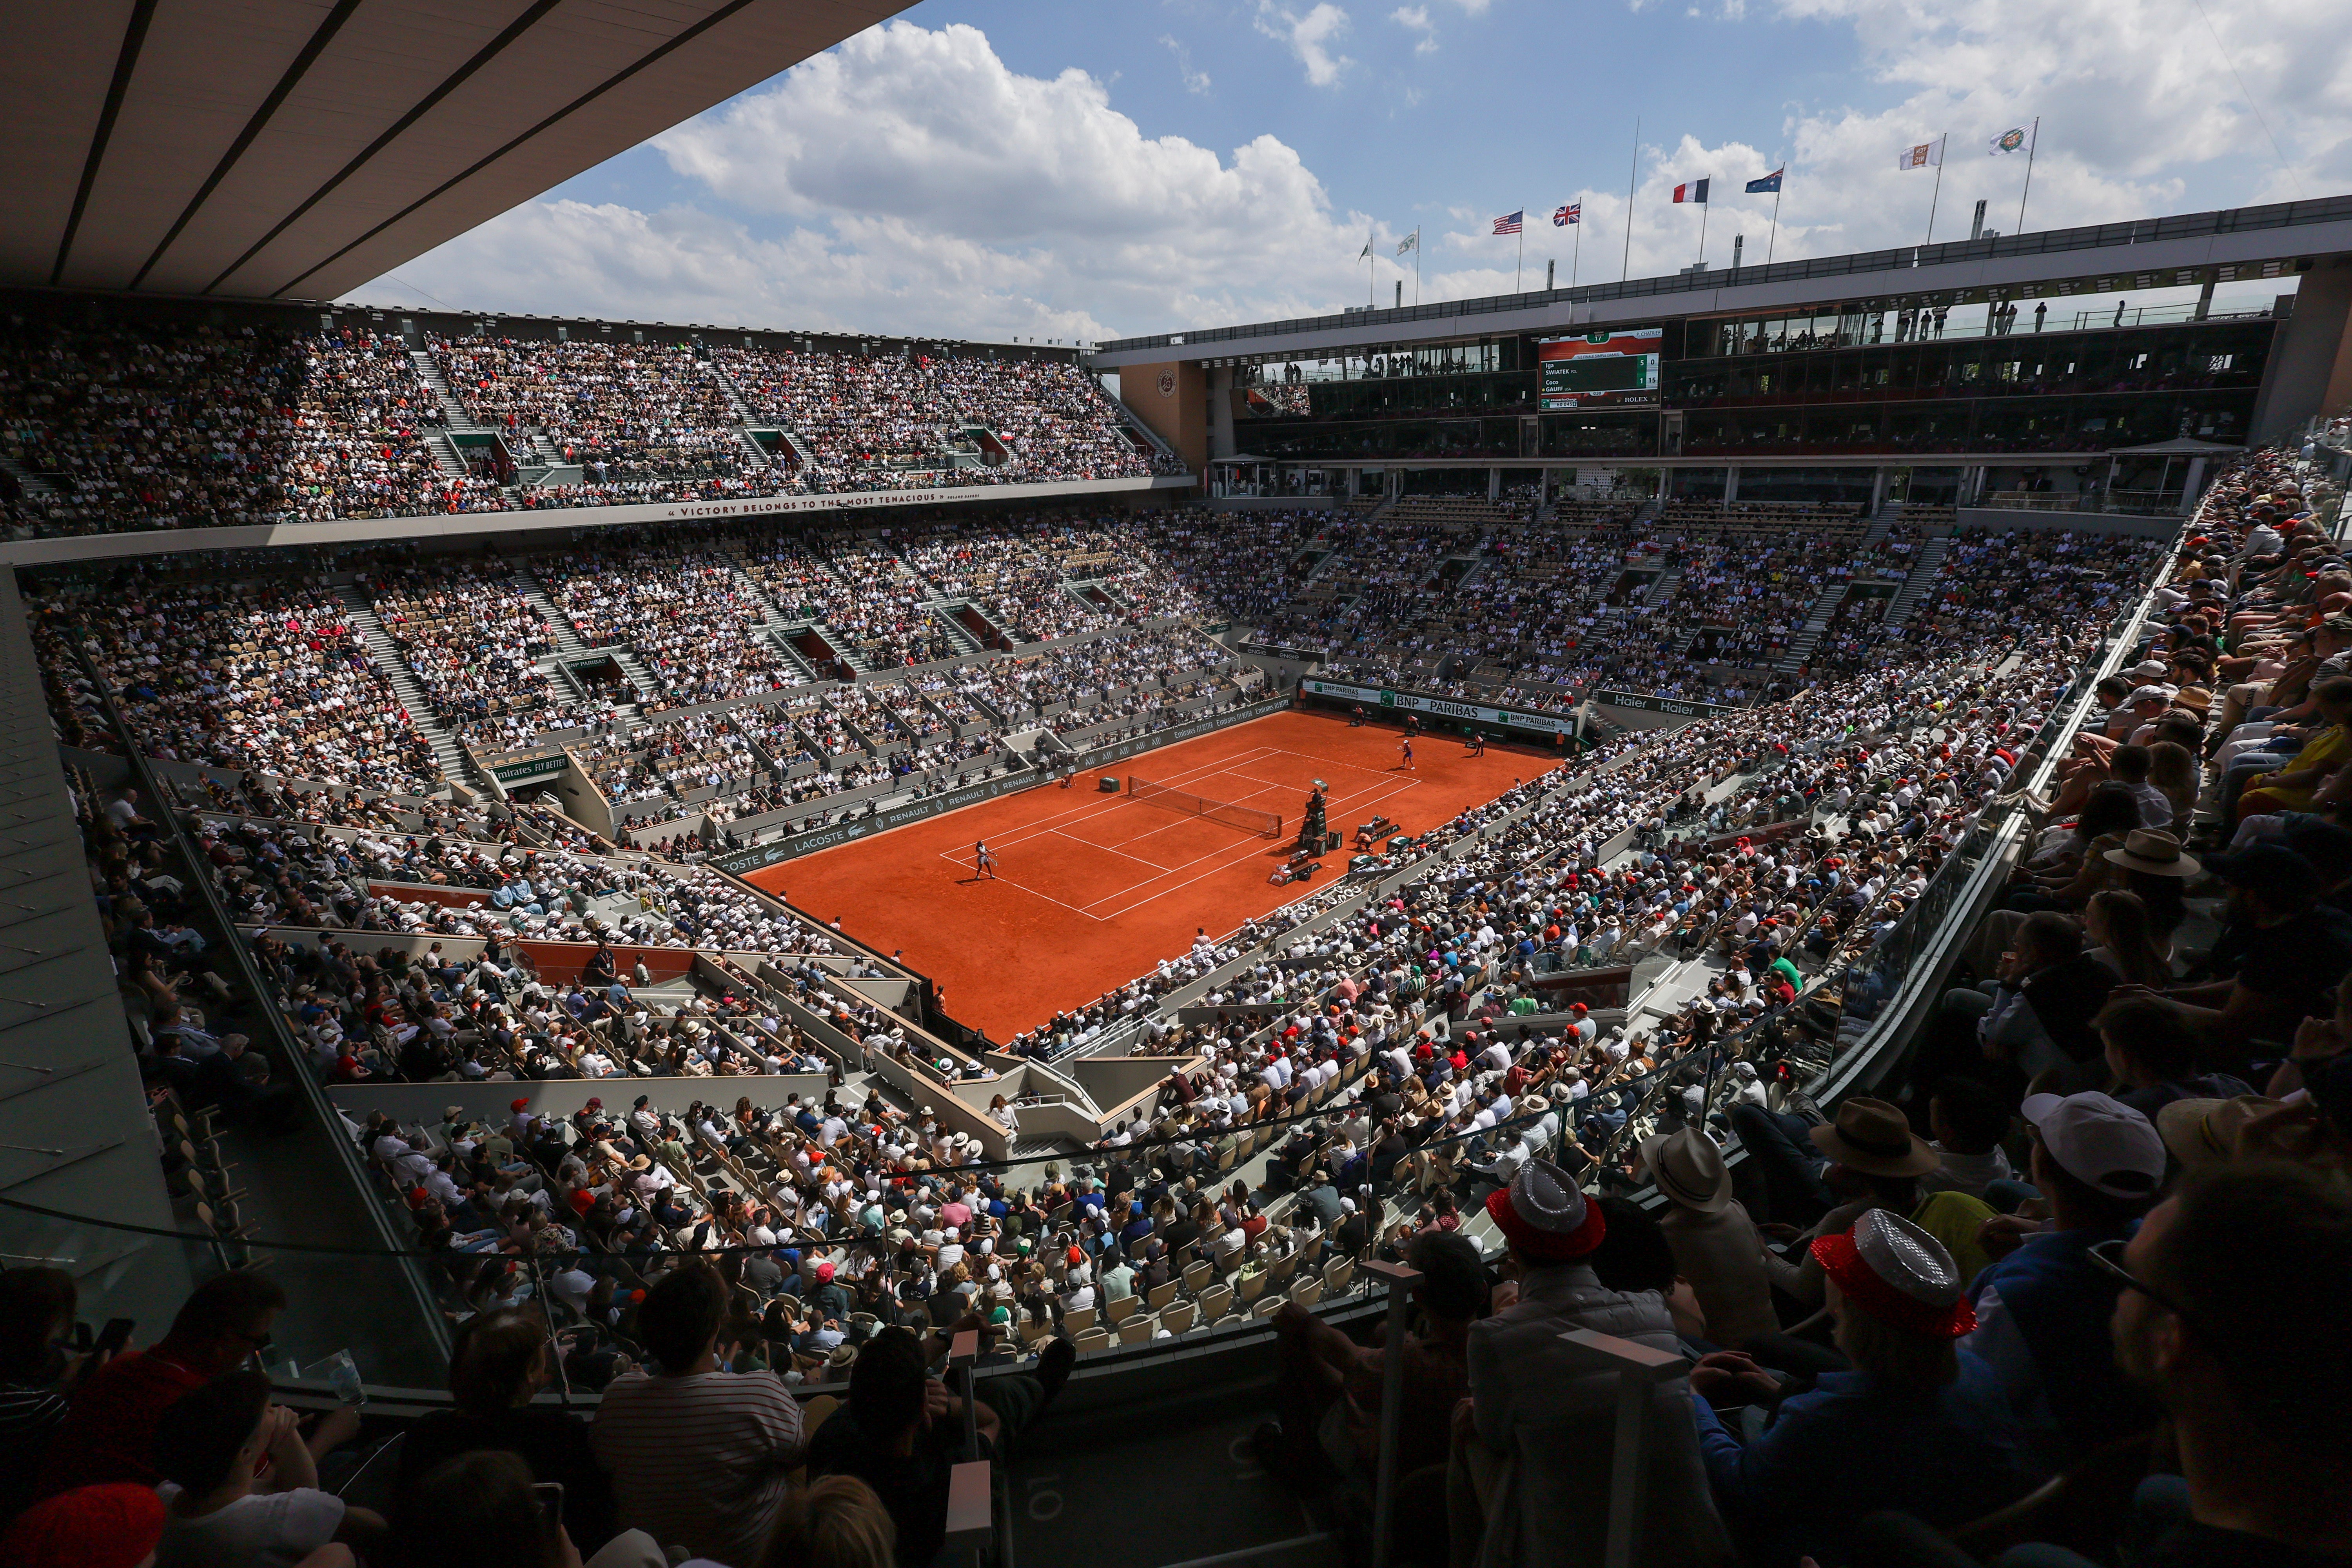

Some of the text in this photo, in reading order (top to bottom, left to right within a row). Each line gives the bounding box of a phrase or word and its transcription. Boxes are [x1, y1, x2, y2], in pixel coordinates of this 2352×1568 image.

[681, 506, 737, 517] VICTORY
[744, 502, 796, 512] BELONGS
[821, 499, 841, 507] THE
[847, 497, 874, 505] MOST
[879, 494, 935, 504] TENACIOUS
[1336, 686, 1359, 695] PARIBAS
[1255, 706, 1274, 715] Emirates
[1279, 699, 1289, 708] BETTER
[1396, 695, 1478, 718] BNP PARIBAS
[1615, 695, 1647, 708] Haier
[1661, 701, 1694, 715] Haier
[1216, 717, 1236, 726] Emirates
[1243, 710, 1252, 719] BETTER
[1510, 714, 1555, 727] BNP PARIBAS
[1174, 728, 1196, 739] Emirates
[1203, 722, 1213, 731] BETTER
[546, 759, 566, 769] BETTER
[1003, 774, 1036, 789] RENAULT
[949, 789, 985, 806] RENAULT
[890, 806, 929, 823] RENAULT
[794, 830, 844, 852] LACOSTE
